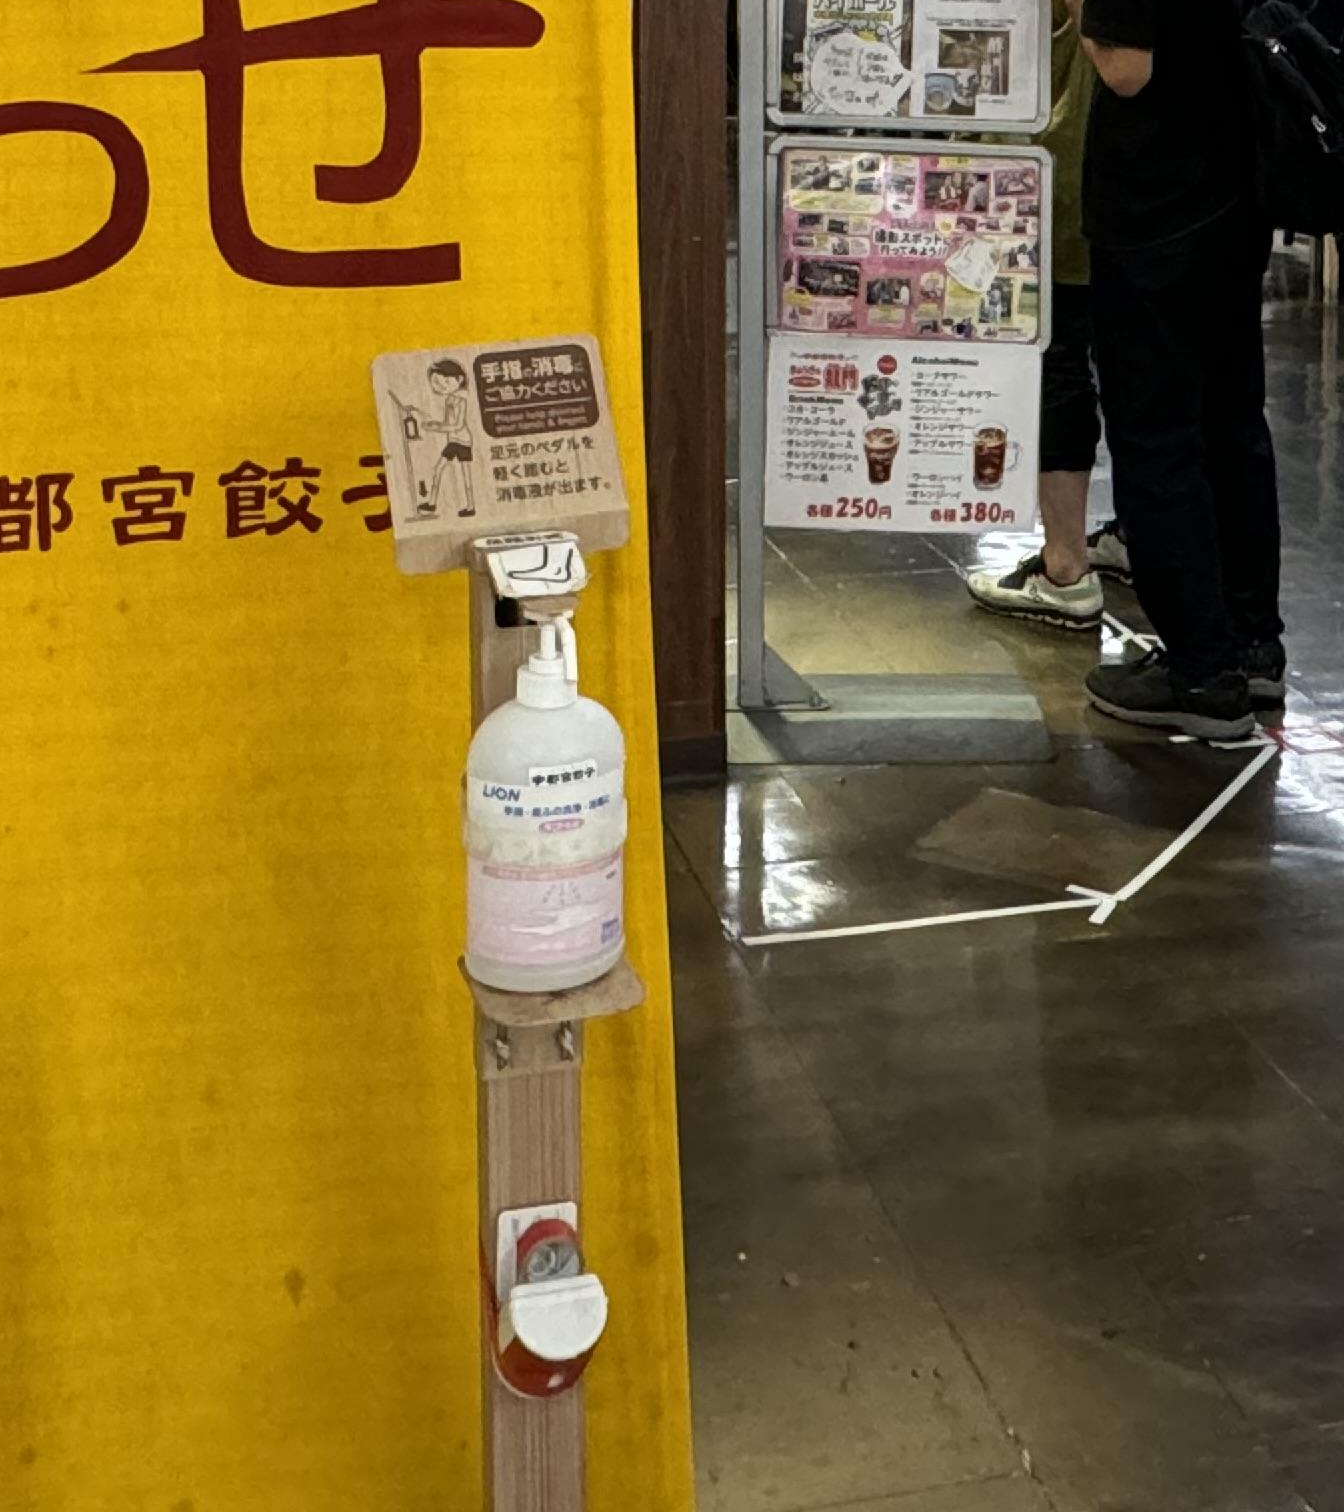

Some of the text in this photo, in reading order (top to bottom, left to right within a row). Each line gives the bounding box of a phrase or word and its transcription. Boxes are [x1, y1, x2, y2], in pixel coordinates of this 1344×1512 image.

[489, 435, 596, 462] 足元のペダルを
[492, 459, 570, 482] 軽く踏むと
[482, 784, 521, 802] LION
